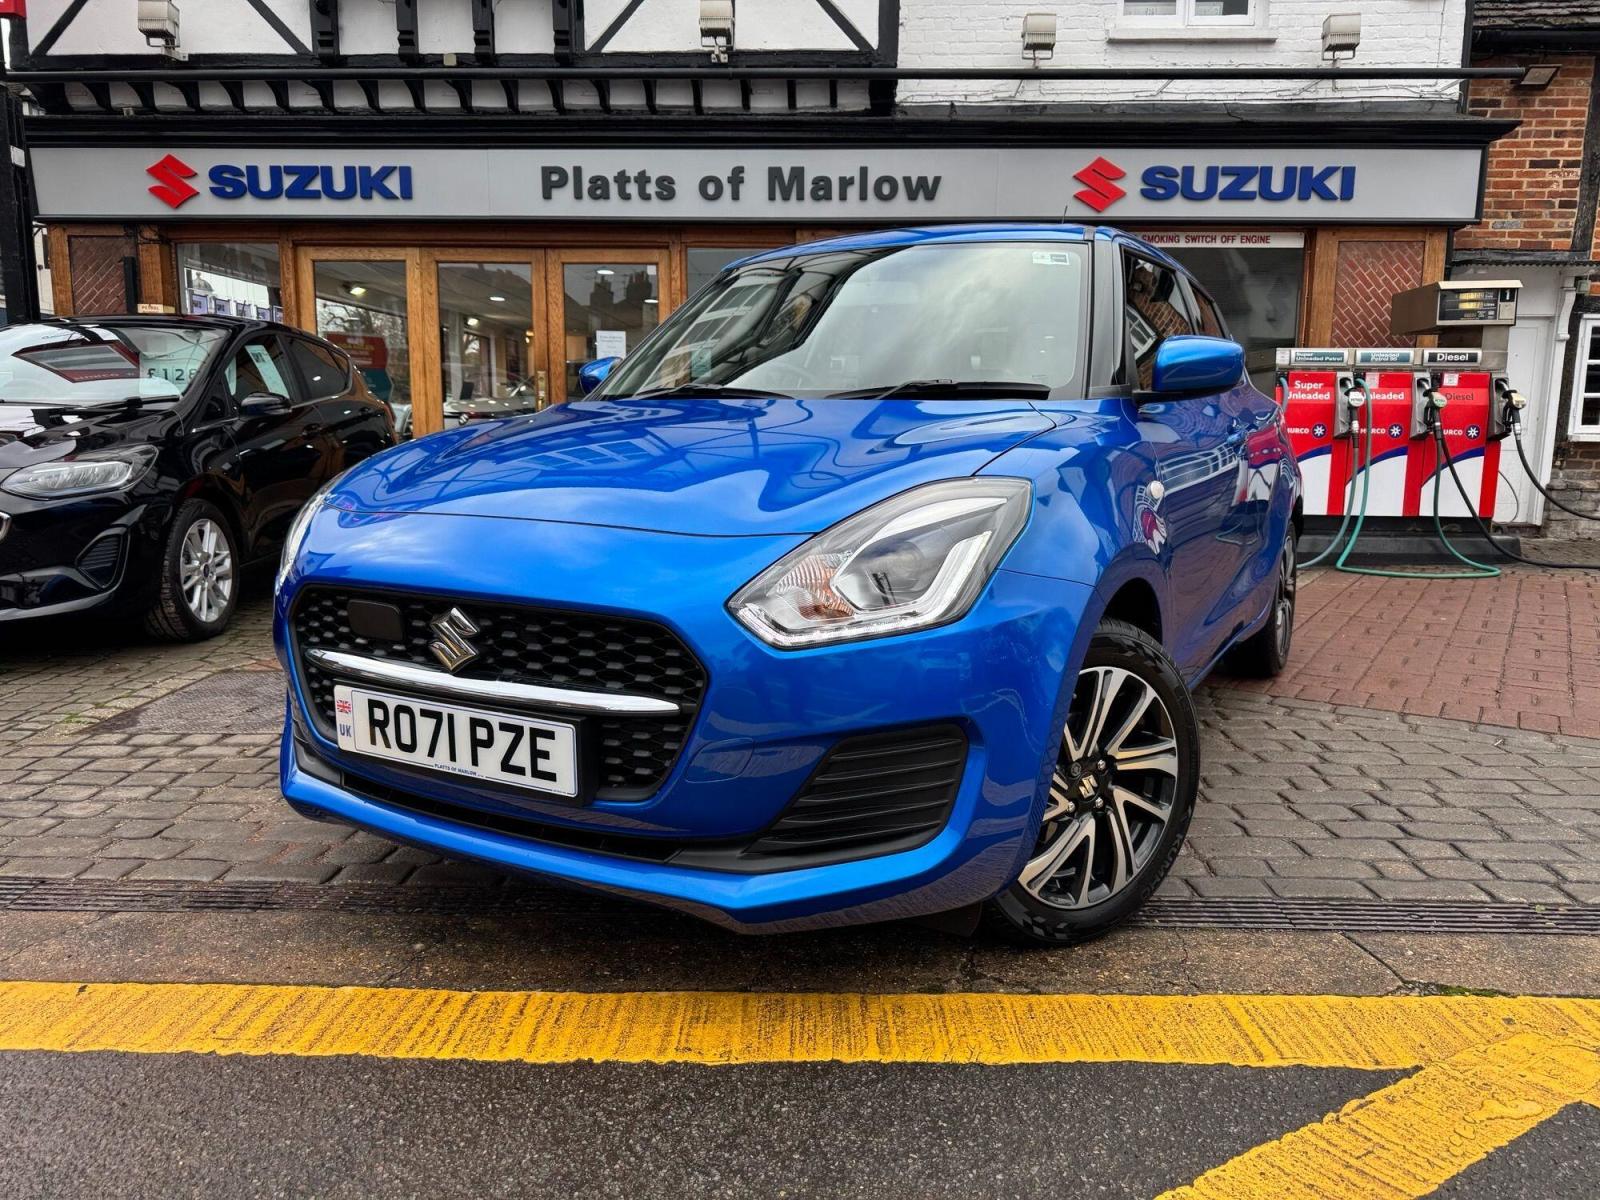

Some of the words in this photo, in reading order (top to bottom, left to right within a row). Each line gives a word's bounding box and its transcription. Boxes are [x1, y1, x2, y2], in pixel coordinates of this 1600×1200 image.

[209, 165, 413, 200] SUZUKI
[541, 166, 677, 201] Platts
[699, 166, 745, 201] of
[768, 166, 942, 202] Marlow
[1140, 165, 1356, 201] SUZUKI
[1142, 234, 1181, 244] SMOKING
[1184, 234, 1217, 244] SWITCH
[1220, 234, 1237, 244] OFF
[1239, 234, 1271, 244] ENGINE
[1436, 353, 1469, 362] Diesel
[1294, 380, 1324, 391] Super
[1446, 392, 1474, 401] Diesel
[1360, 427, 1386, 435] MRCO
[339, 723, 352, 738] UK
[367, 698, 457, 763] RO71
[469, 716, 558, 783] PZE
